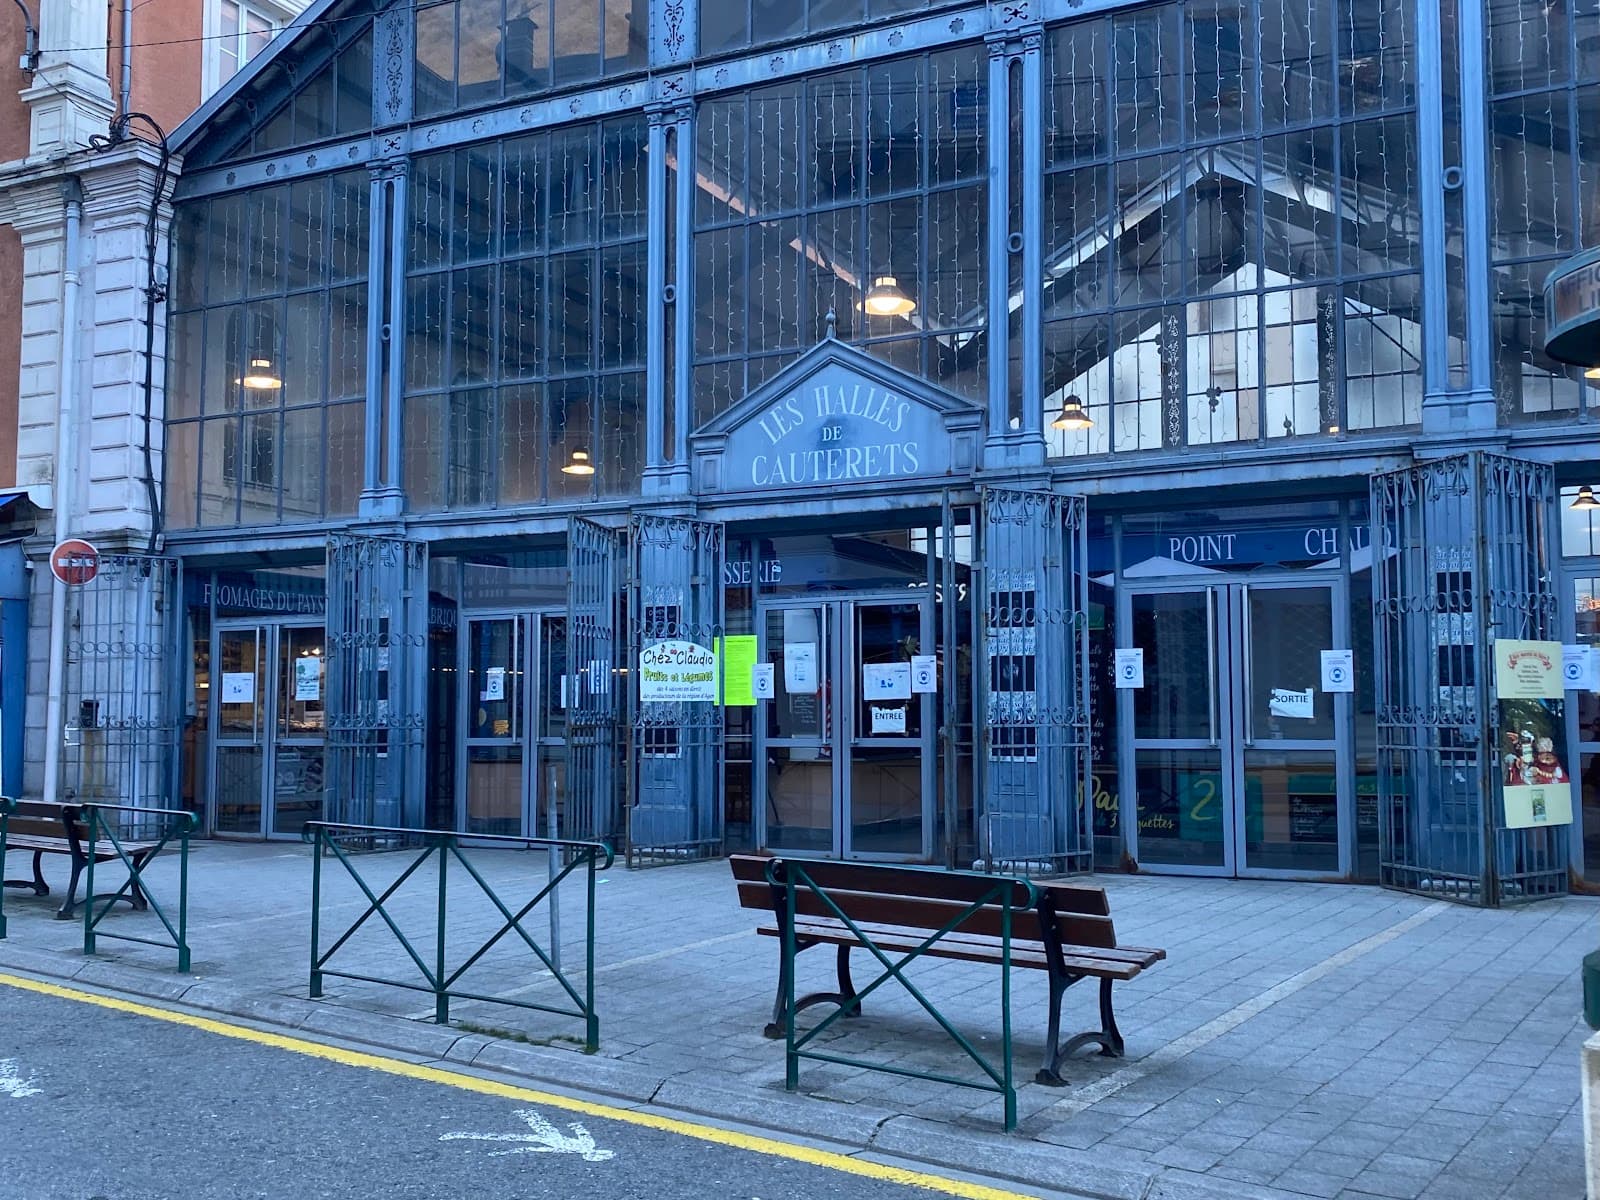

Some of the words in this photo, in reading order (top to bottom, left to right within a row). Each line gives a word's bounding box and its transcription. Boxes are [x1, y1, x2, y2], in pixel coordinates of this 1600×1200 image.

[759, 397, 804, 445] LES
[814, 384, 911, 432] HALLES
[822, 425, 843, 442] DE
[751, 441, 919, 486] CAUTERETS
[1169, 533, 1237, 562] POINT
[723, 559, 782, 585] SSEIE
[203, 583, 274, 610] FOMAGES
[277, 591, 295, 612] DU
[643, 650, 672, 666] Chez
[676, 651, 713, 667] Claudio
[643, 667, 669, 682] Fruits
[670, 672, 679, 682] et
[1275, 695, 1309, 703] SORTIE
